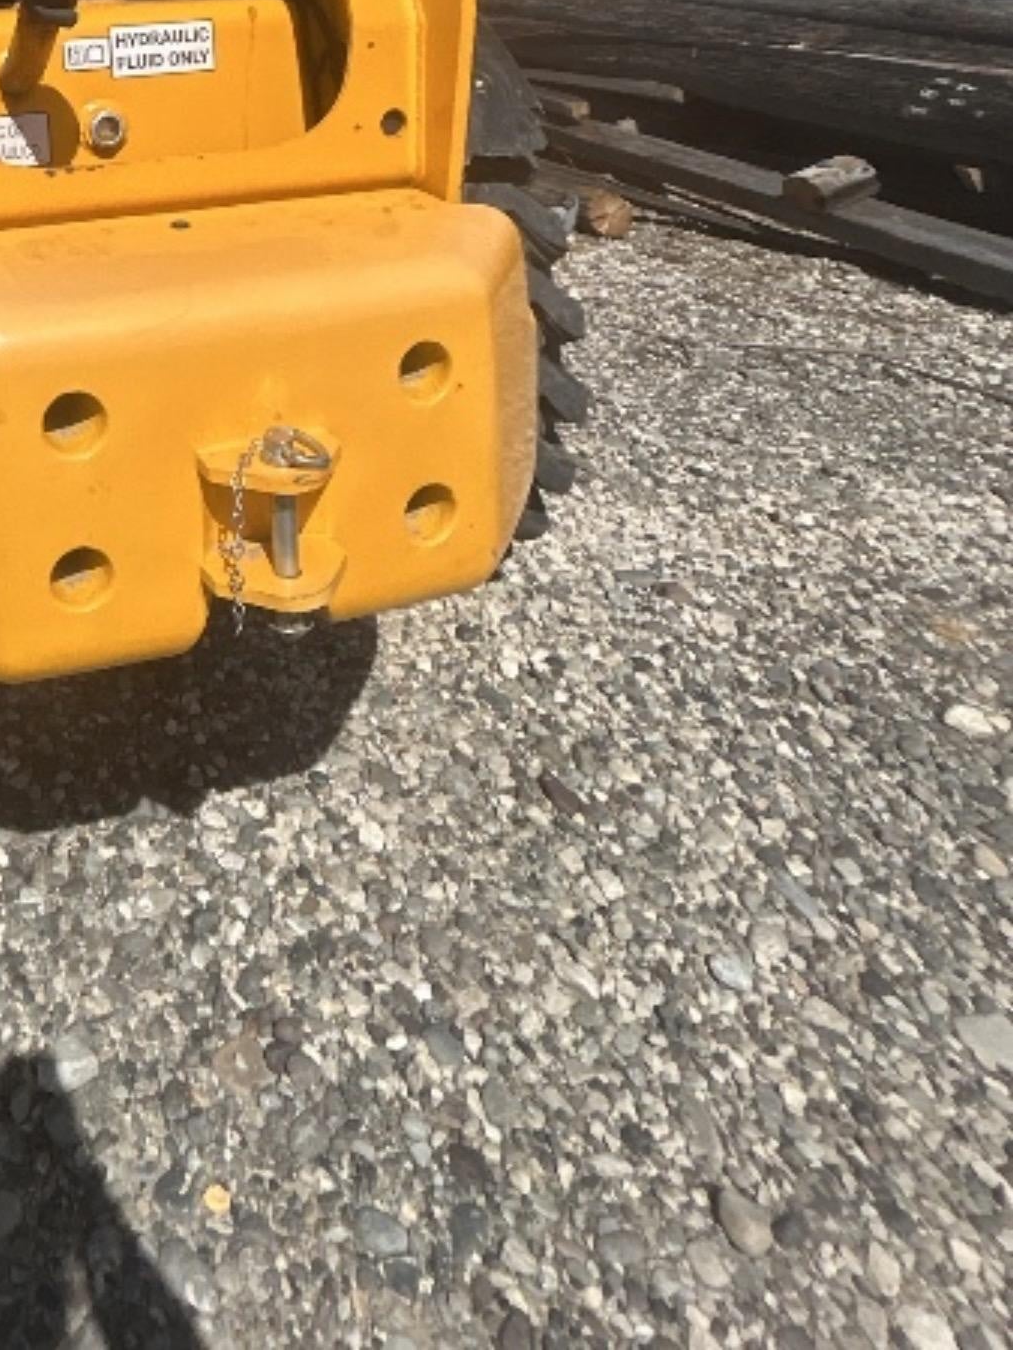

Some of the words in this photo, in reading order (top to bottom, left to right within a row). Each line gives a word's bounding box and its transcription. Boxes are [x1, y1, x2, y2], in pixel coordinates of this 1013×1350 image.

[115, 26, 210, 48] HYDRAULIC
[116, 53, 165, 70] FLUID
[169, 48, 210, 66] ONLY
